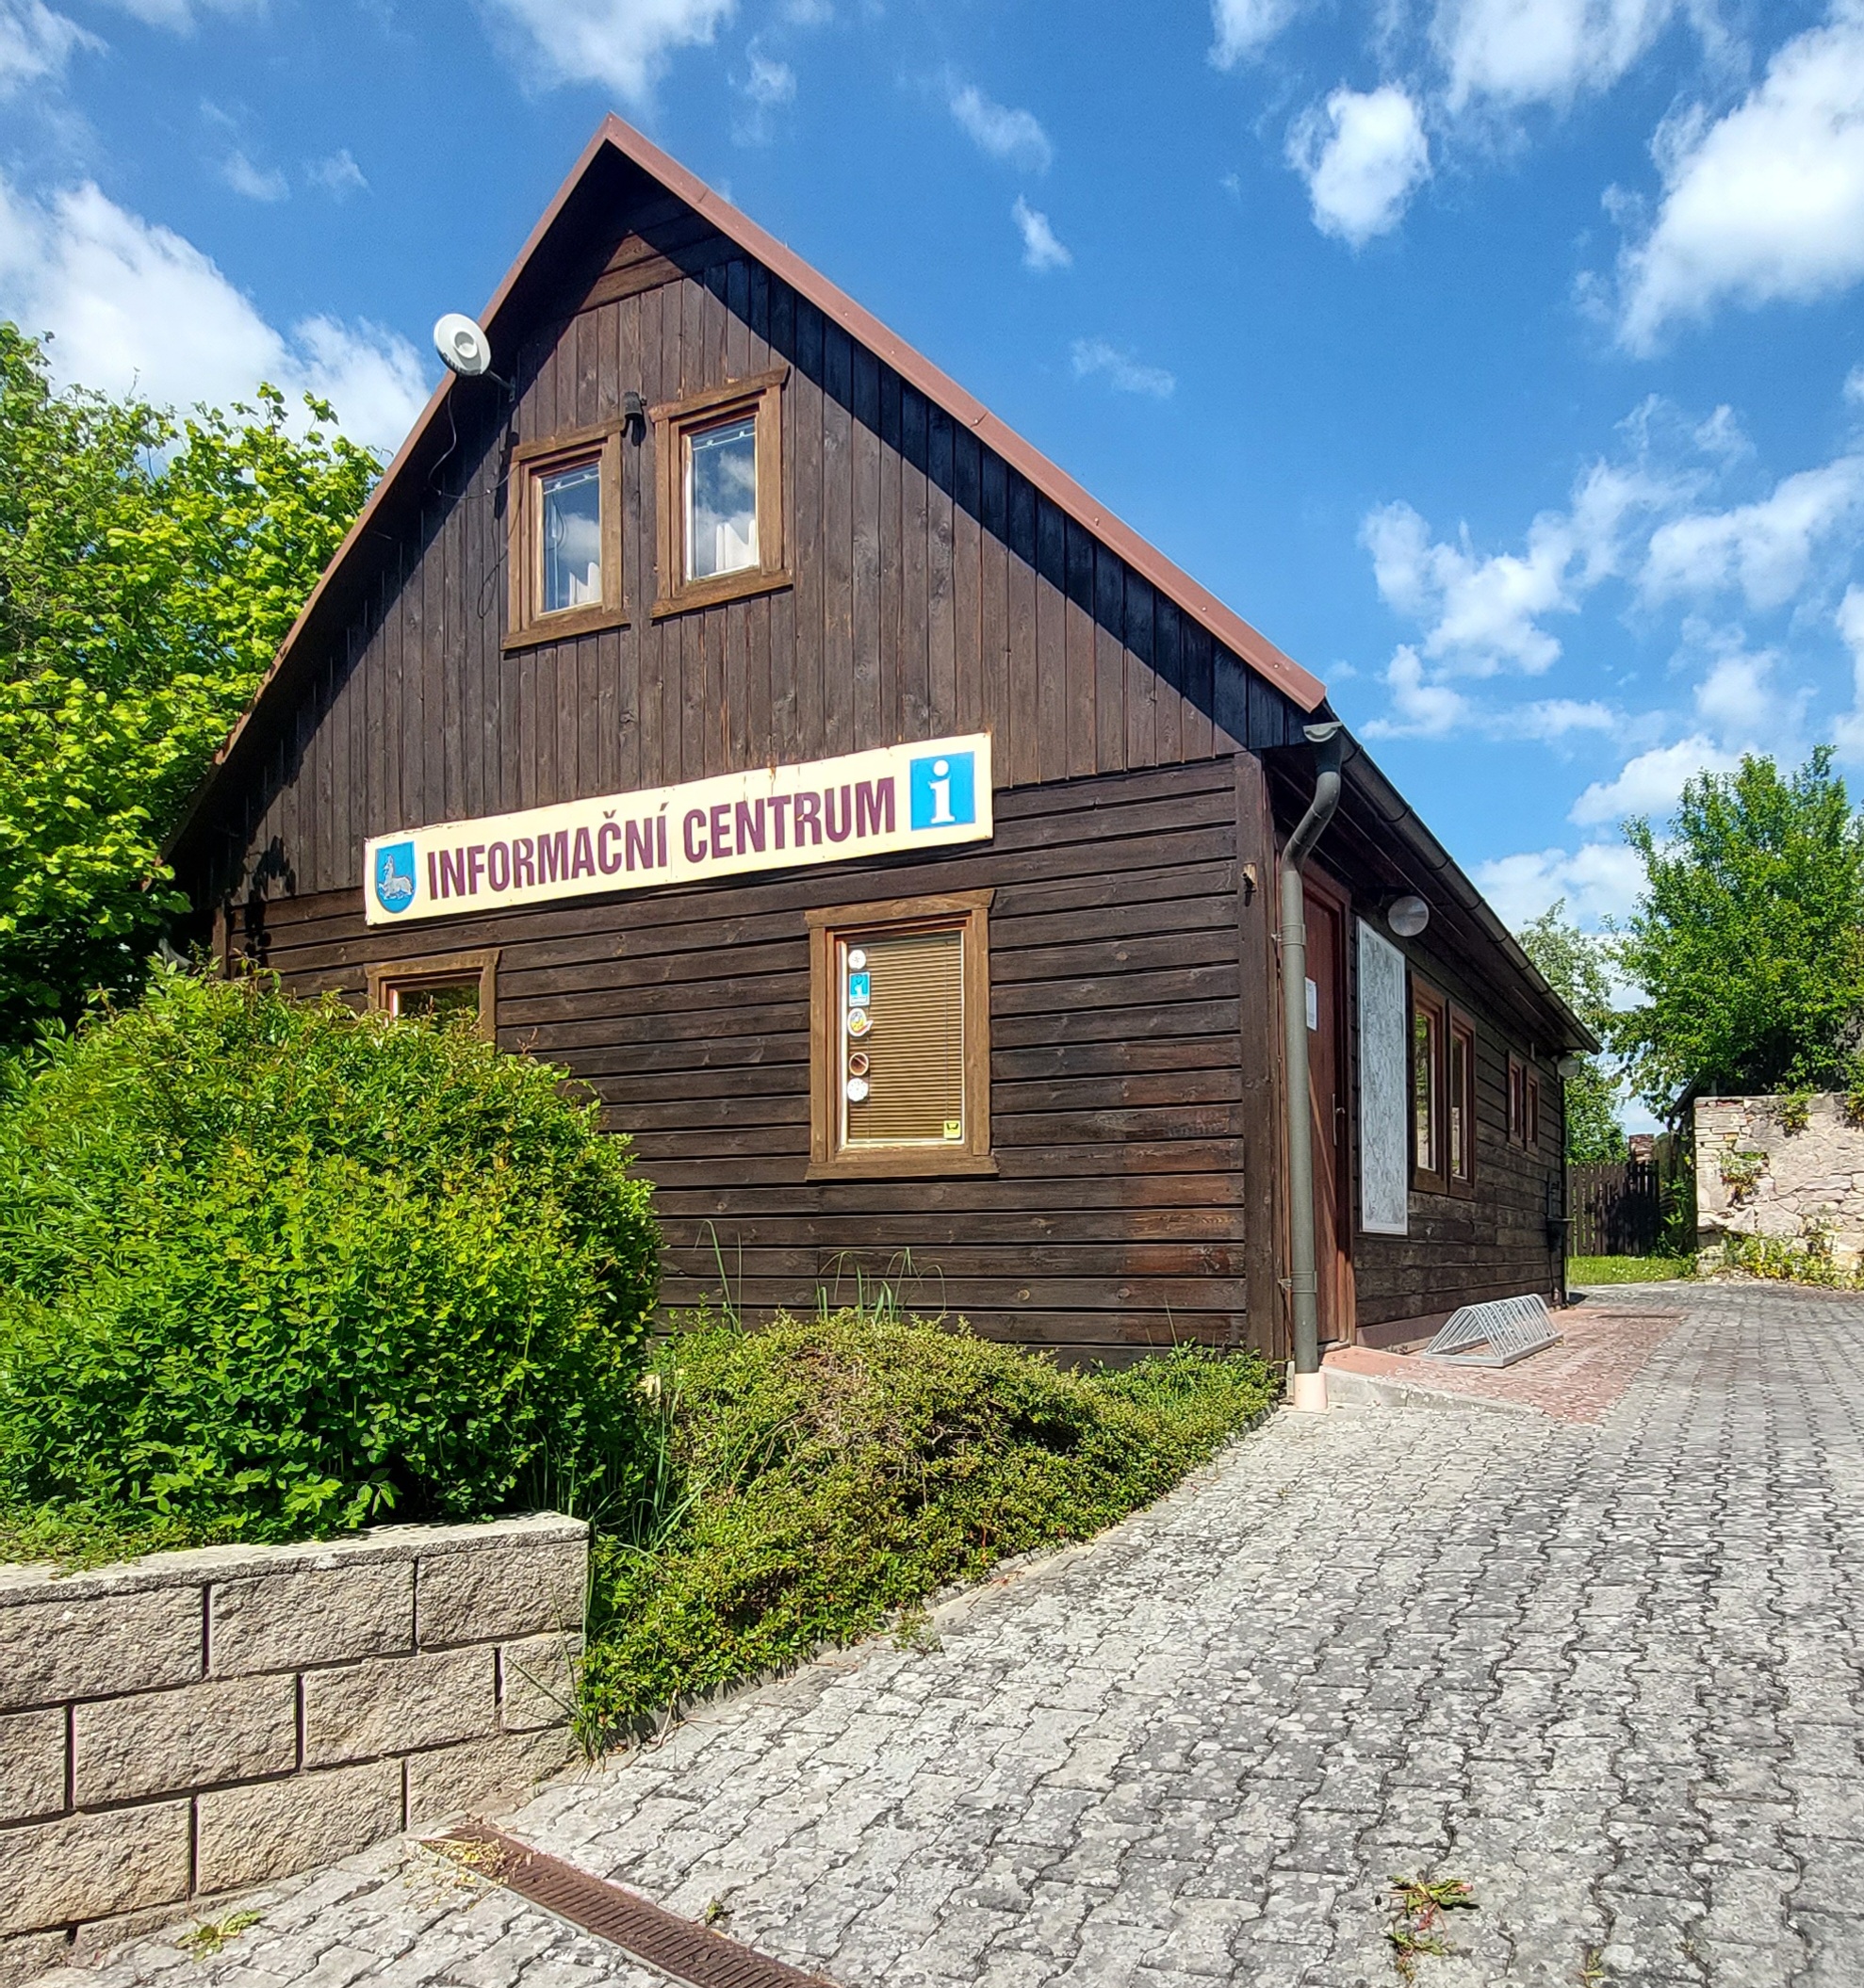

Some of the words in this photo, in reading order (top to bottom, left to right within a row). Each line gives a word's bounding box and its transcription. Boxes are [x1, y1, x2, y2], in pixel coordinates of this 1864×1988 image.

[427, 801, 669, 900] INFORMAČNÍ
[682, 776, 895, 863] CENTRUM
[927, 759, 956, 823] i
